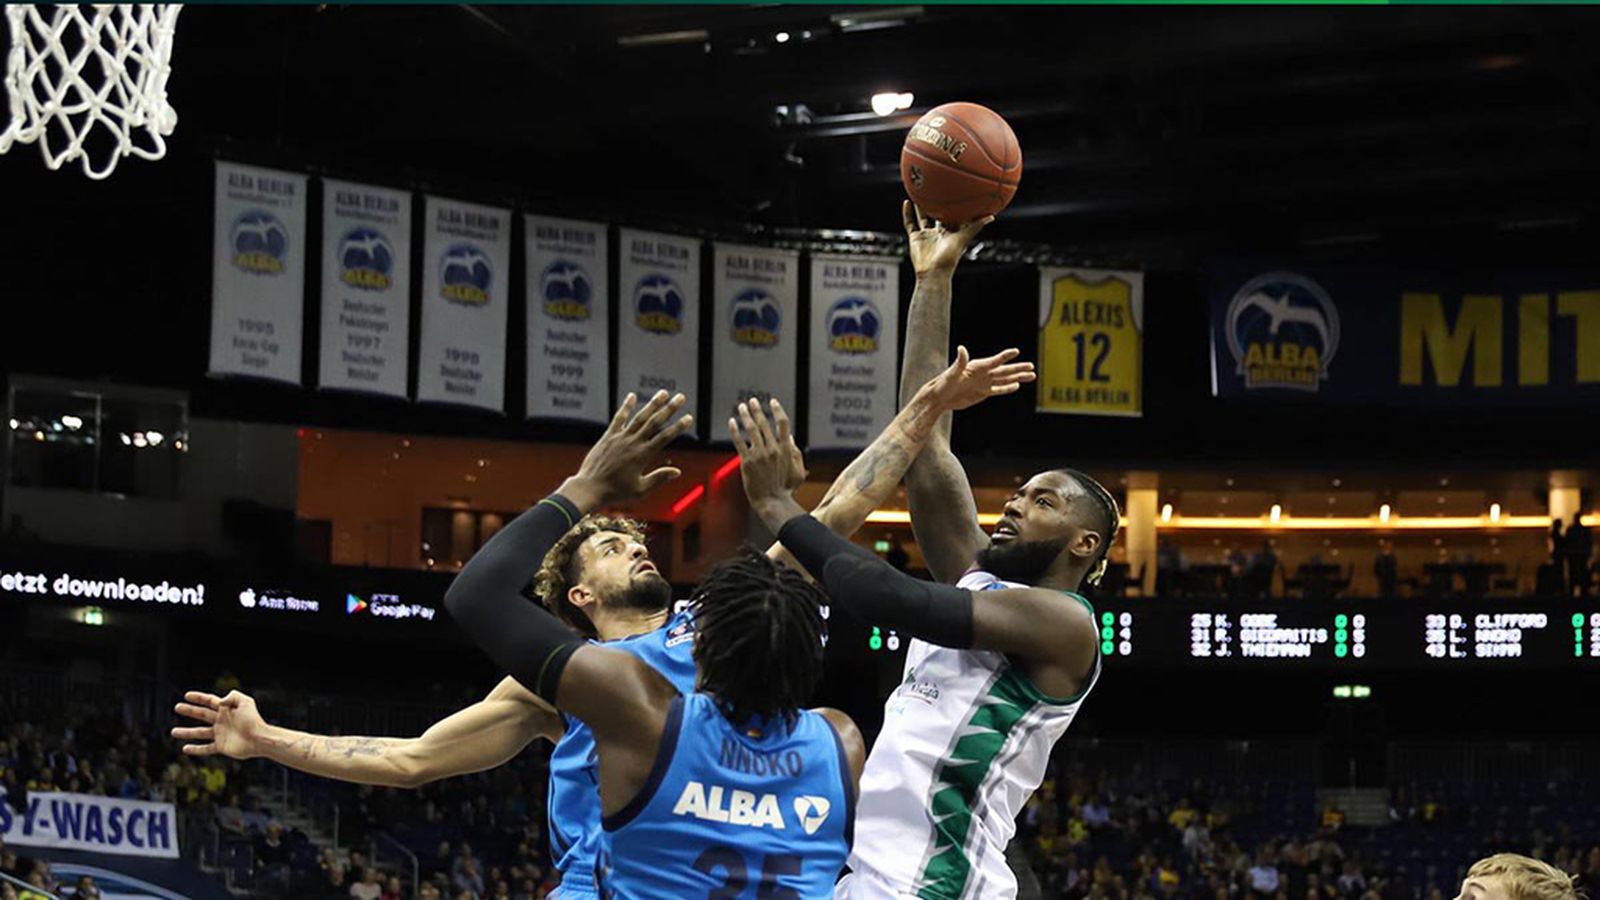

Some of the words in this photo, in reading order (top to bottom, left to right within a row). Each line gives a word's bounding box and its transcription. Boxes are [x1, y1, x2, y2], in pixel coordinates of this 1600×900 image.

[1060, 301, 1125, 330] ALEXIS
[1399, 290, 1600, 388] MIT
[1071, 331, 1111, 382] 12
[1243, 341, 1320, 371] ALBA
[53, 573, 205, 606] downloaden!
[1101, 612, 1115, 626] 0
[1119, 612, 1132, 626] 0
[1334, 614, 1348, 628] 0
[1352, 614, 1366, 628] 0
[1475, 613, 1547, 628] CLIFFORD
[1572, 612, 1585, 627] 0
[1101, 626, 1115, 641] 0
[1119, 626, 1132, 641] 4
[1191, 629, 1210, 642] 31
[1334, 628, 1348, 643] 0
[1101, 641, 1115, 655] 0
[1119, 641, 1132, 655] 0
[1334, 643, 1348, 657] 0
[1352, 643, 1366, 657] 0
[719, 738, 803, 777] NNOKO
[672, 781, 786, 830] ALBA
